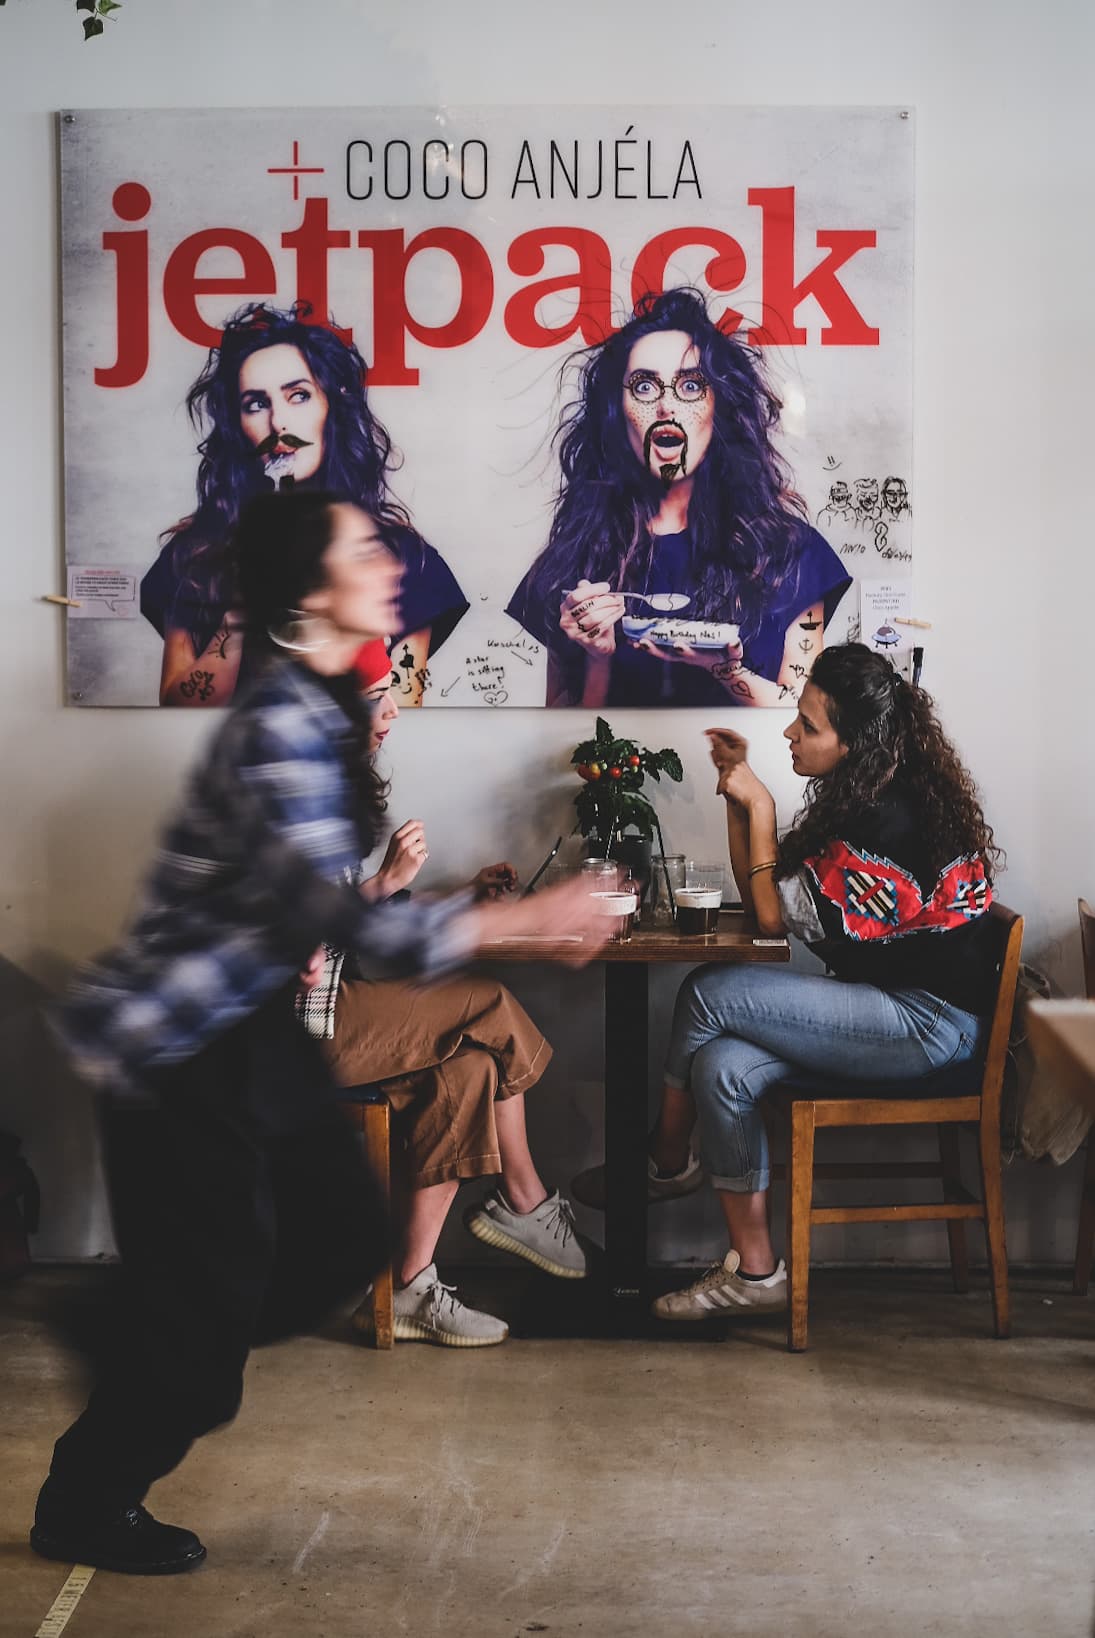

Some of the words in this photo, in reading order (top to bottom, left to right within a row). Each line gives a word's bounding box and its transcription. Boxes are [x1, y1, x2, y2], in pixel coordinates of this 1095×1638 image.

[346, 139, 489, 200] COCO
[512, 126, 702, 200] ANJÉLA
[94, 182, 880, 389] jetpack
